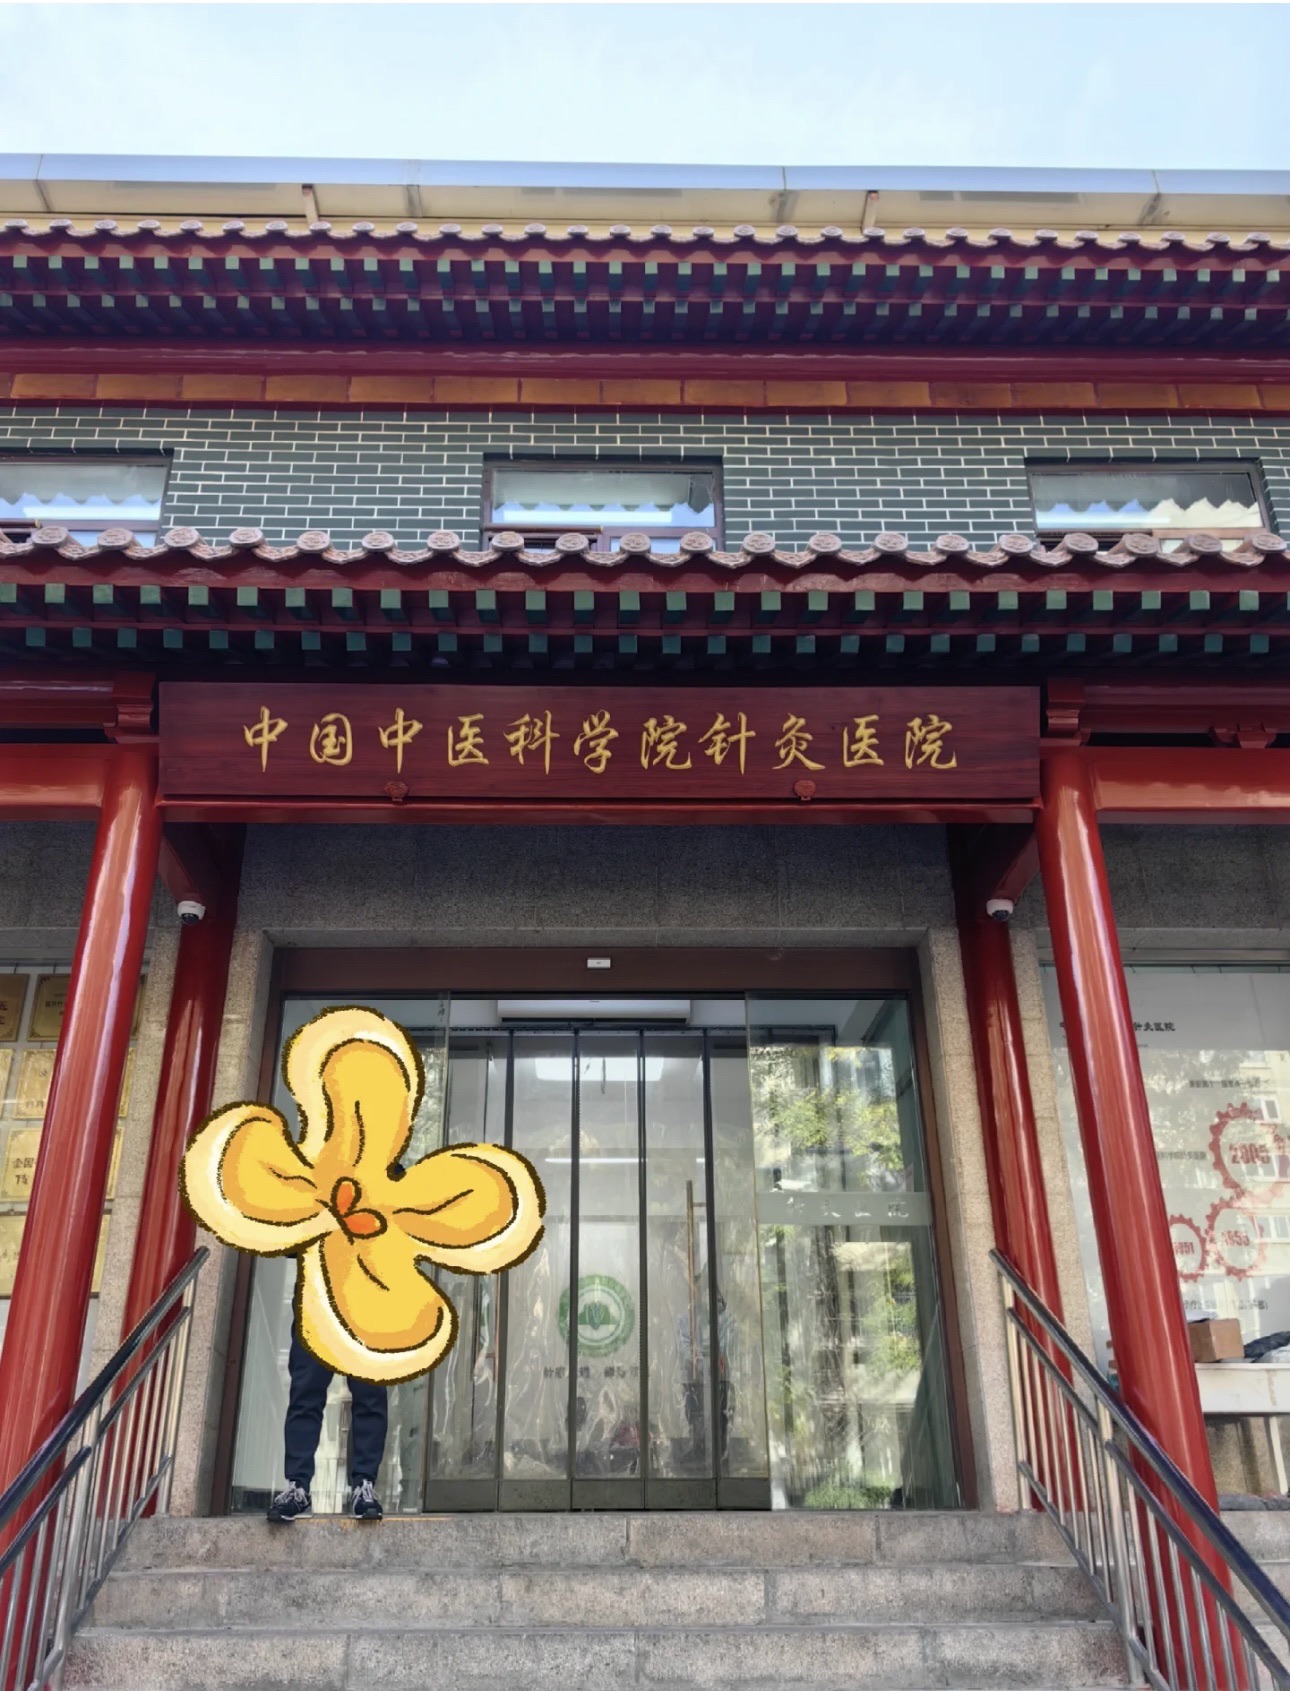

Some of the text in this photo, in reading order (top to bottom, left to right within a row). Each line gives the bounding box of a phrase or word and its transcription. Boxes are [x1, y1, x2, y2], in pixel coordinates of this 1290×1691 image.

[243, 705, 957, 775] 中国中医科学院针灸医院
